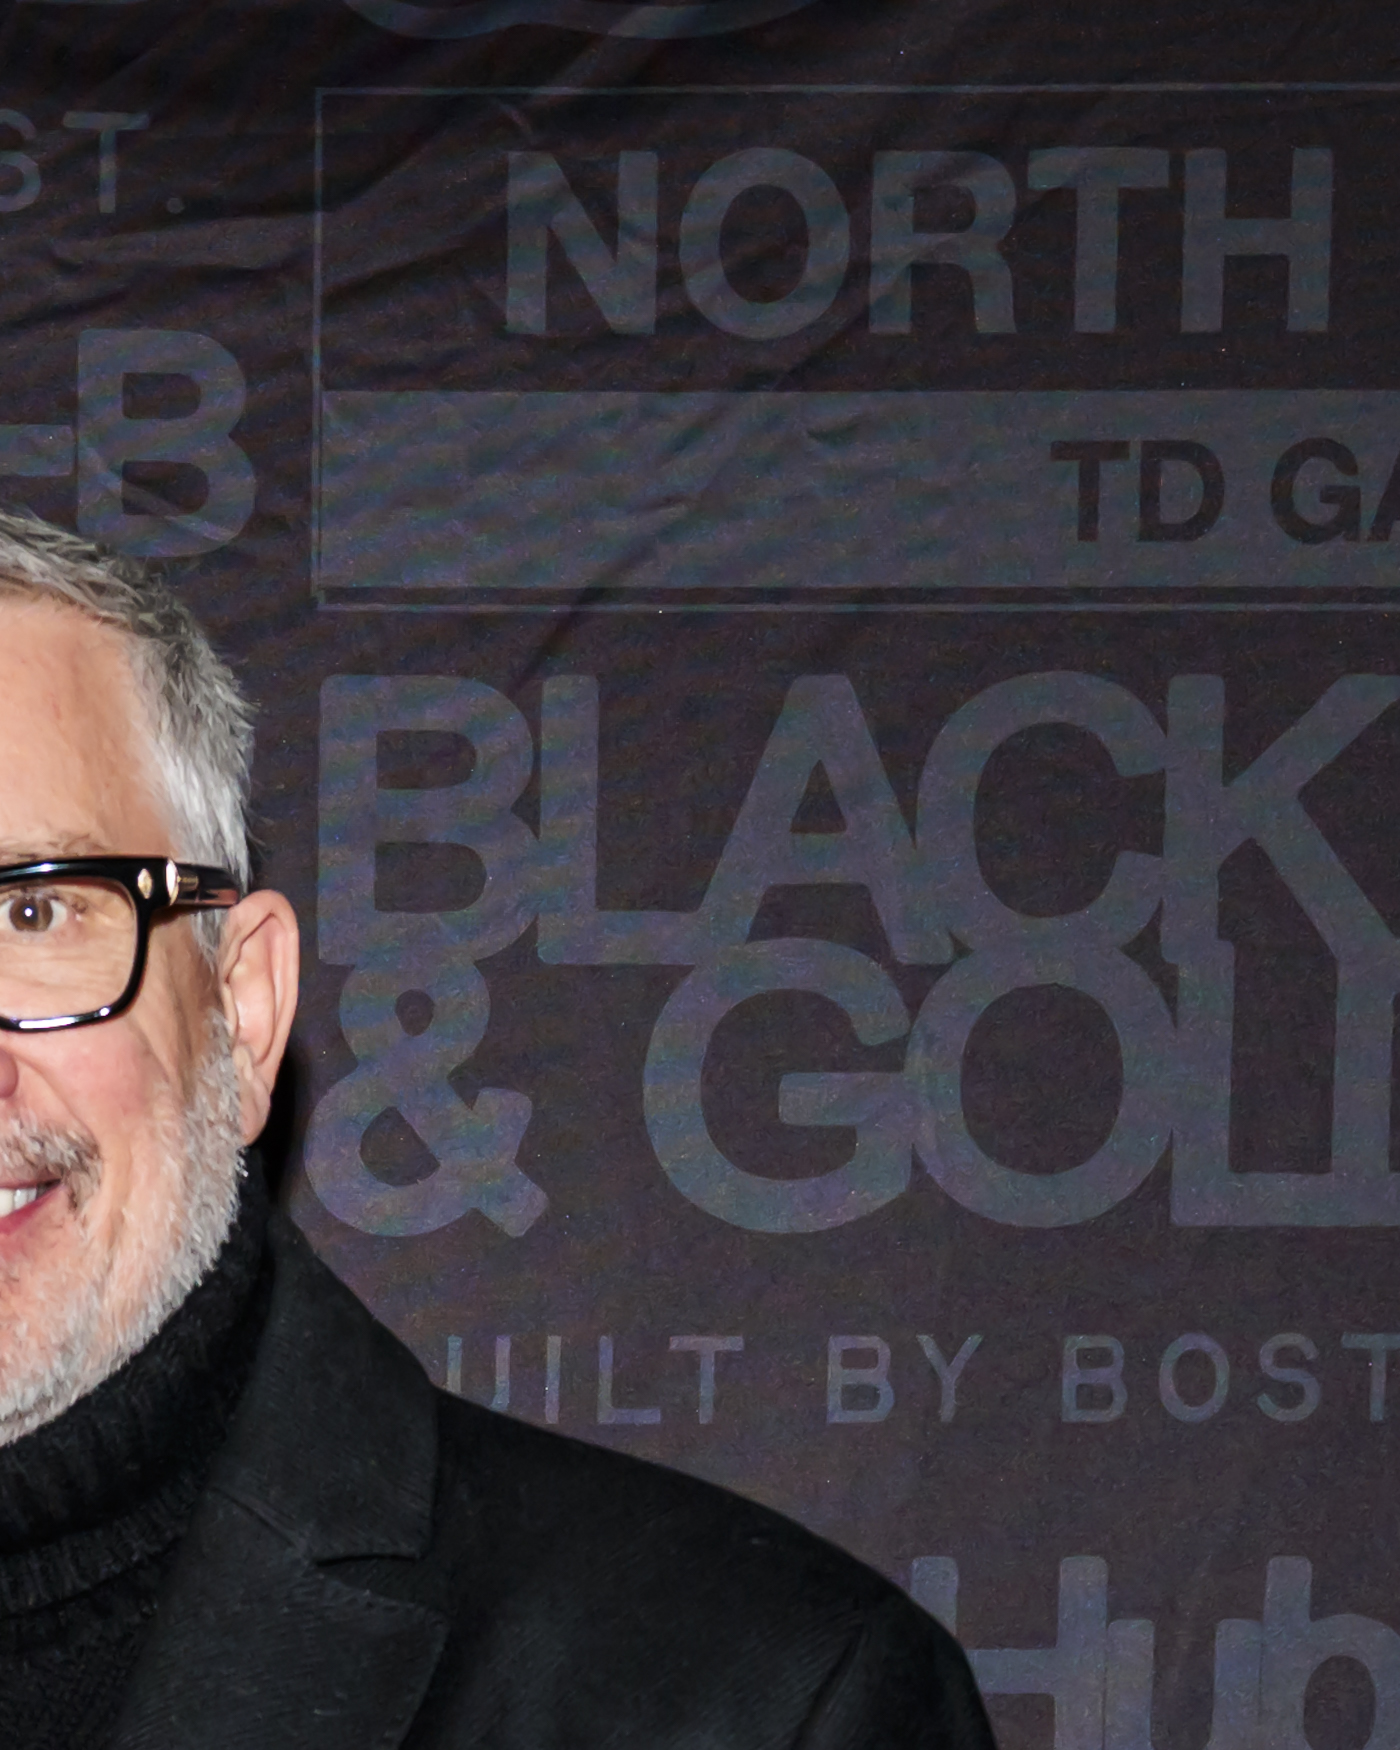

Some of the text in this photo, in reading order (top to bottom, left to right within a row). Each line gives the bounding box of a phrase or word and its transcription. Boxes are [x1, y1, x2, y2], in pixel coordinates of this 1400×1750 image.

[504, 146, 1333, 341] NORTH
[1050, 438, 1226, 543] TD
[316, 671, 1400, 965] BLACK
[303, 918, 550, 1238] &
[826, 1334, 983, 1426] BY
[1060, 1333, 1400, 1426] BOST
